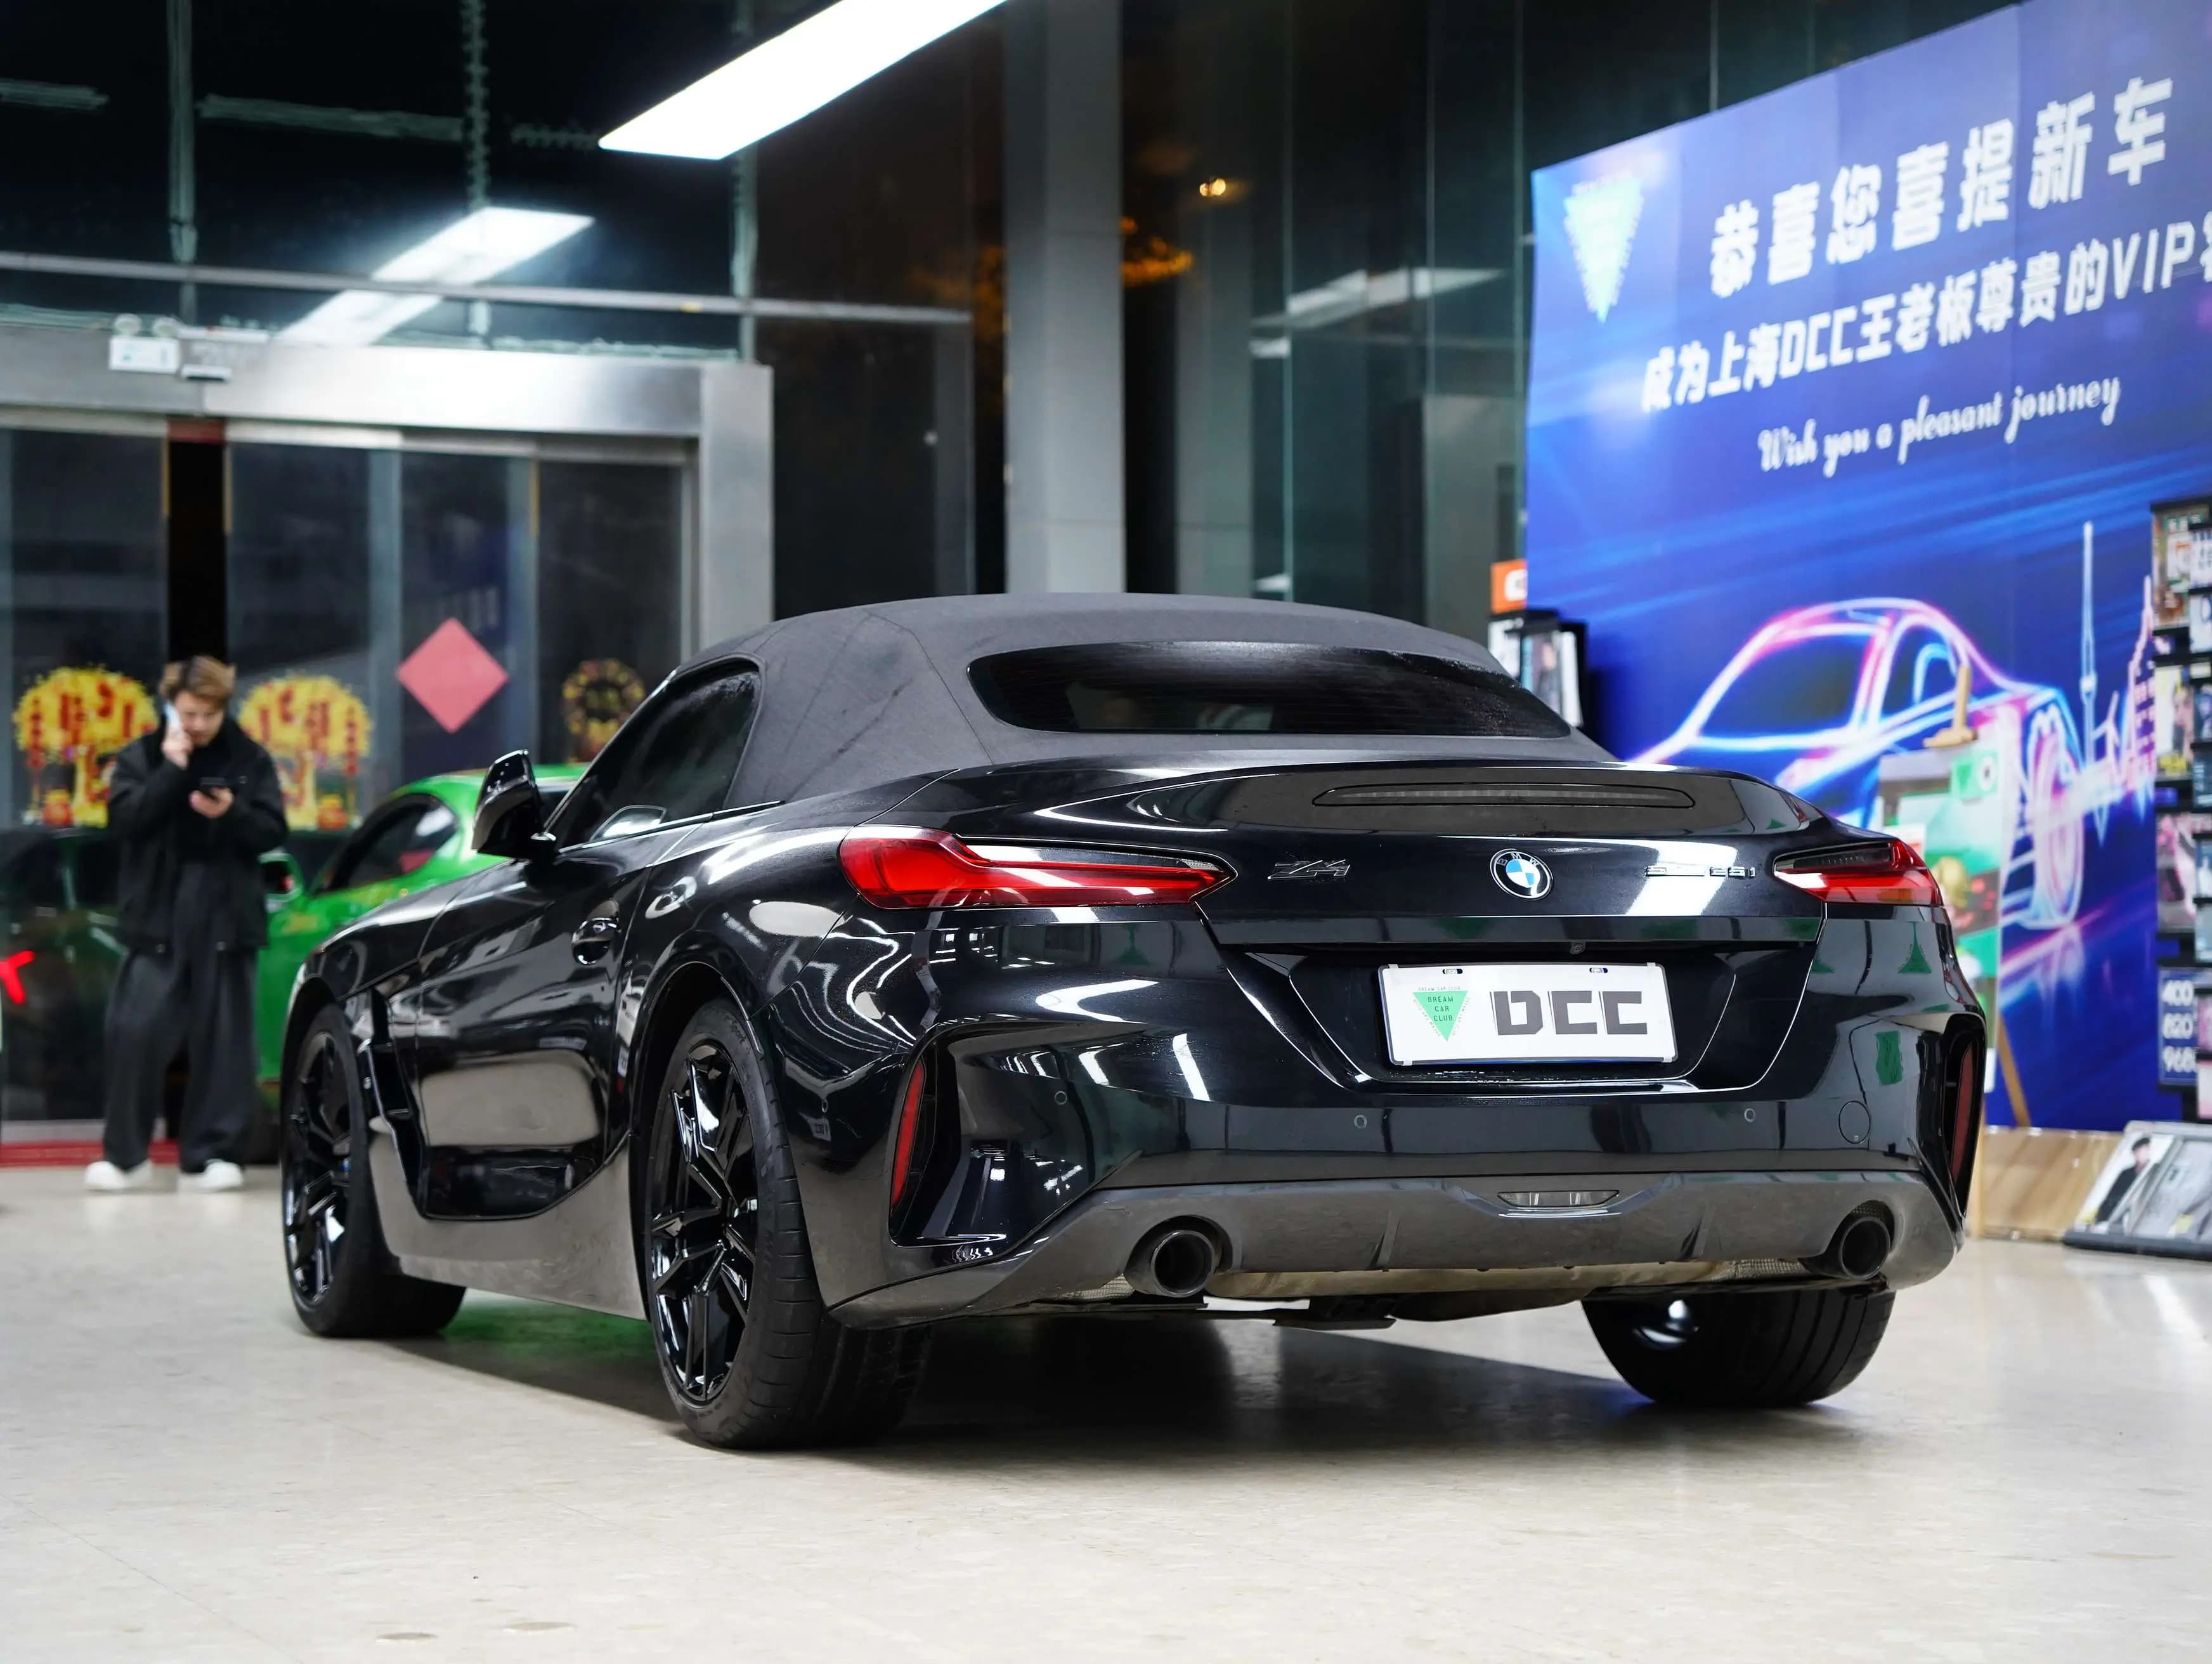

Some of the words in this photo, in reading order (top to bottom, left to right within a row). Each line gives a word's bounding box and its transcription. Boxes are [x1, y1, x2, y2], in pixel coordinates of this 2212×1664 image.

[1710, 77, 2173, 298] 恭喜您喜提新车
[1757, 418, 1818, 472] Wish
[1823, 427, 1870, 478] you
[1875, 422, 1894, 449] a
[1897, 394, 2003, 465] pleasant
[2004, 377, 2121, 444] journey
[1497, 852, 1540, 866] BMW
[1490, 991, 1648, 1036] DCC
